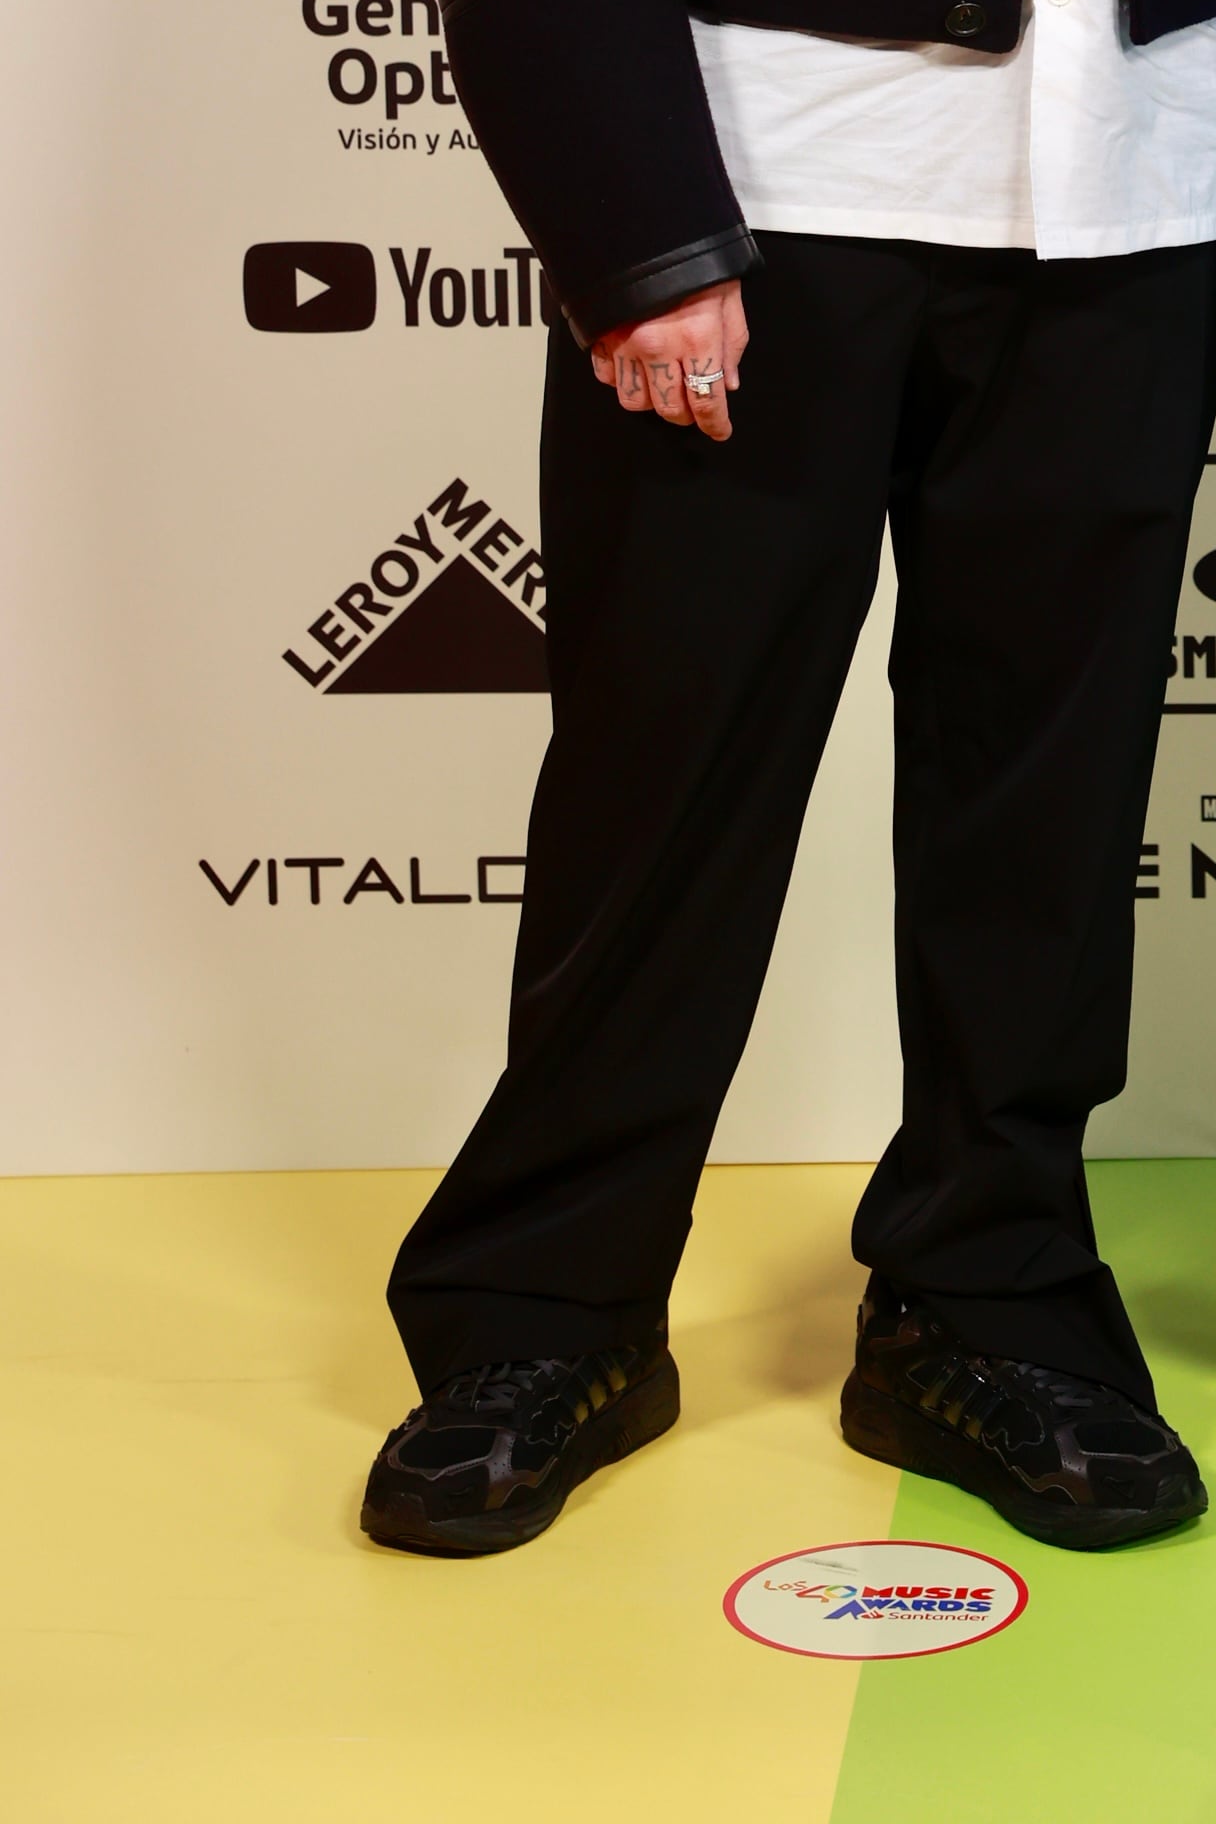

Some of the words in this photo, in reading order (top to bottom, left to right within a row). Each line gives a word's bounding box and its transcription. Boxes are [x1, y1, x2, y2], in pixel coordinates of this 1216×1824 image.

[338, 127, 417, 150] Visión
[426, 133, 440, 155] y
[388, 247, 552, 328] YouT
[281, 513, 446, 689] LEROY
[426, 477, 547, 623] MER
[861, 1585, 997, 1600] MUSIC
[823, 1598, 993, 1620] AWARDS
[887, 1611, 989, 1622] Santander
